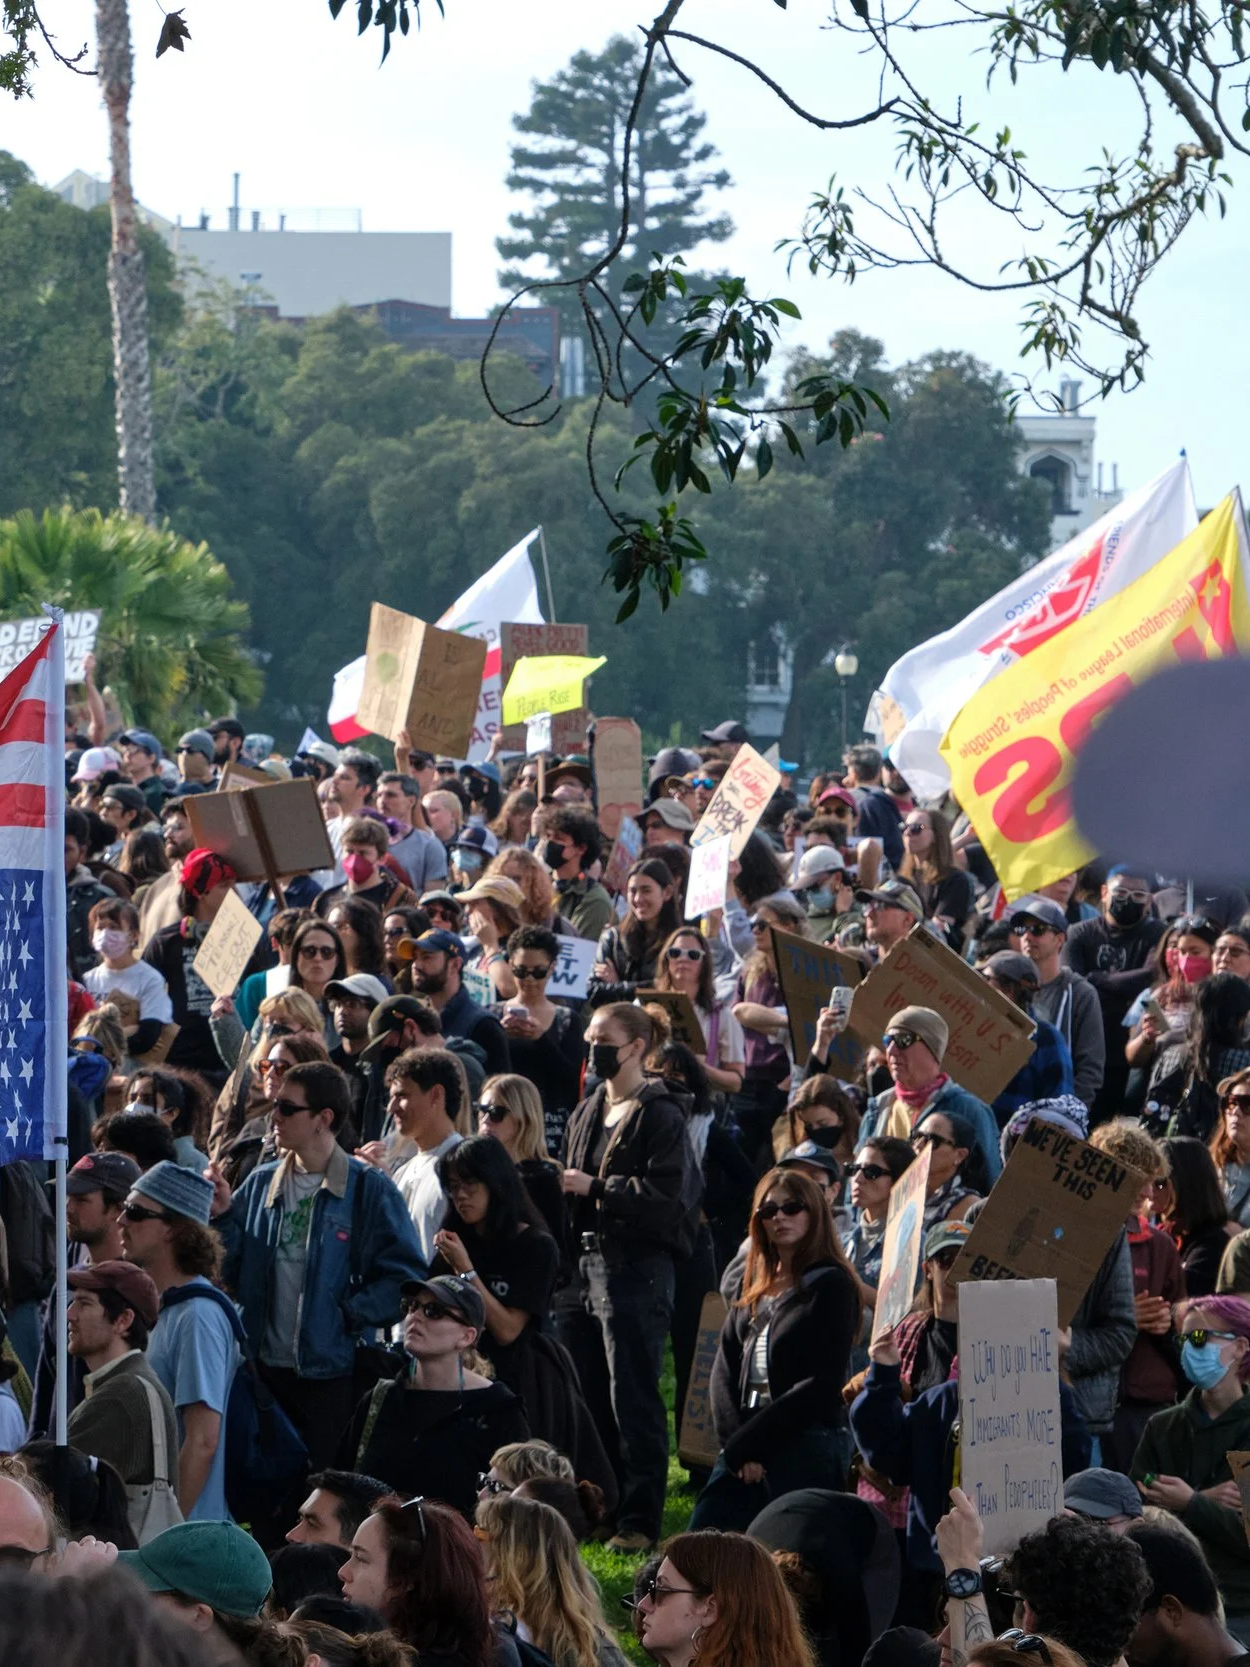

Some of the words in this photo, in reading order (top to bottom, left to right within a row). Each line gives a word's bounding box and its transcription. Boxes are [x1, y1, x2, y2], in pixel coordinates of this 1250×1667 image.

[709, 789, 749, 835] BREAK
[213, 960, 232, 993] ICE
[229, 921, 248, 958] OUT
[893, 953, 940, 996] Down
[937, 991, 976, 1031] with
[1022, 1119, 1078, 1164] WE'VE
[1074, 1147, 1127, 1193] SEEN
[1052, 1163, 1097, 1201] THIS
[1030, 1328, 1051, 1372] HATE
[1026, 1407, 1054, 1445] MORE
[976, 1482, 998, 1516] THAN
